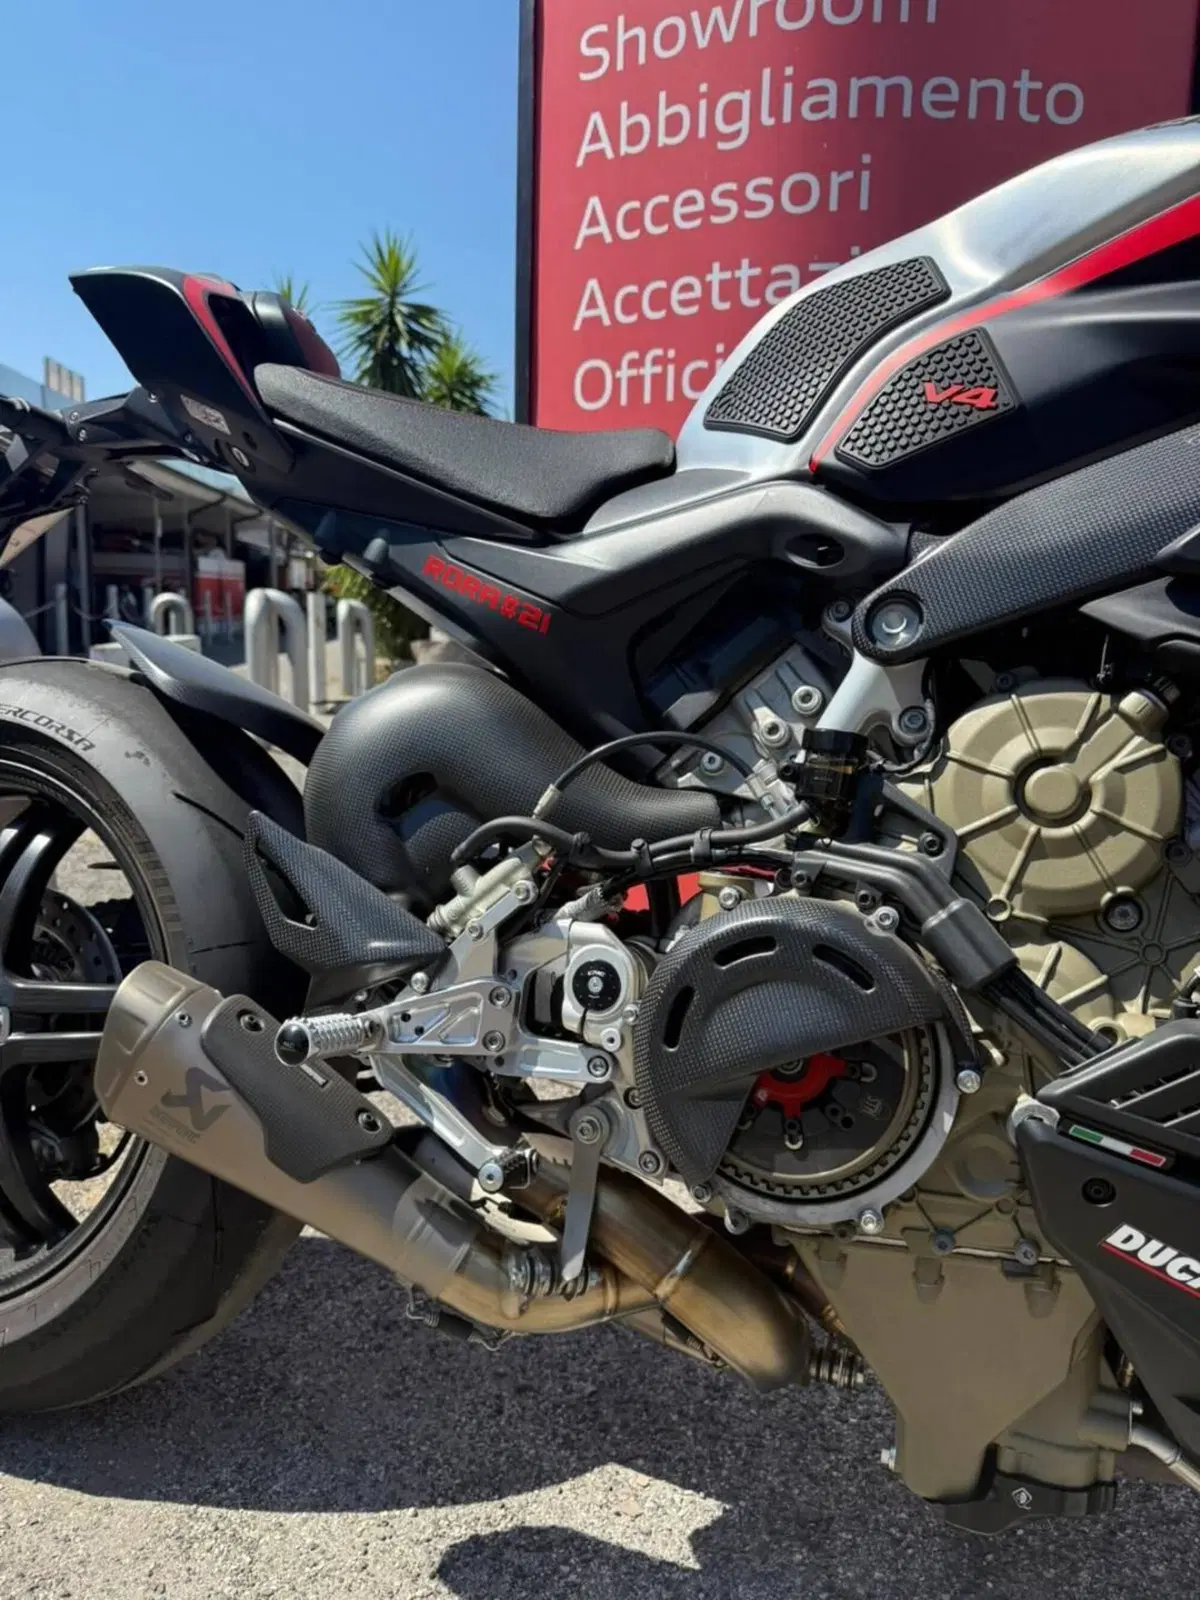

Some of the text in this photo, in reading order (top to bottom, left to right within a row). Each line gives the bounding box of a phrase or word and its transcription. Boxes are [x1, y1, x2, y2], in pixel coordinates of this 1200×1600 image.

[575, 66, 1085, 168] Abbigliamento
[573, 153, 872, 250] Accessori
[572, 246, 861, 331] Accetta
[923, 381, 998, 409] V4
[1105, 1223, 1200, 1289] DUC
